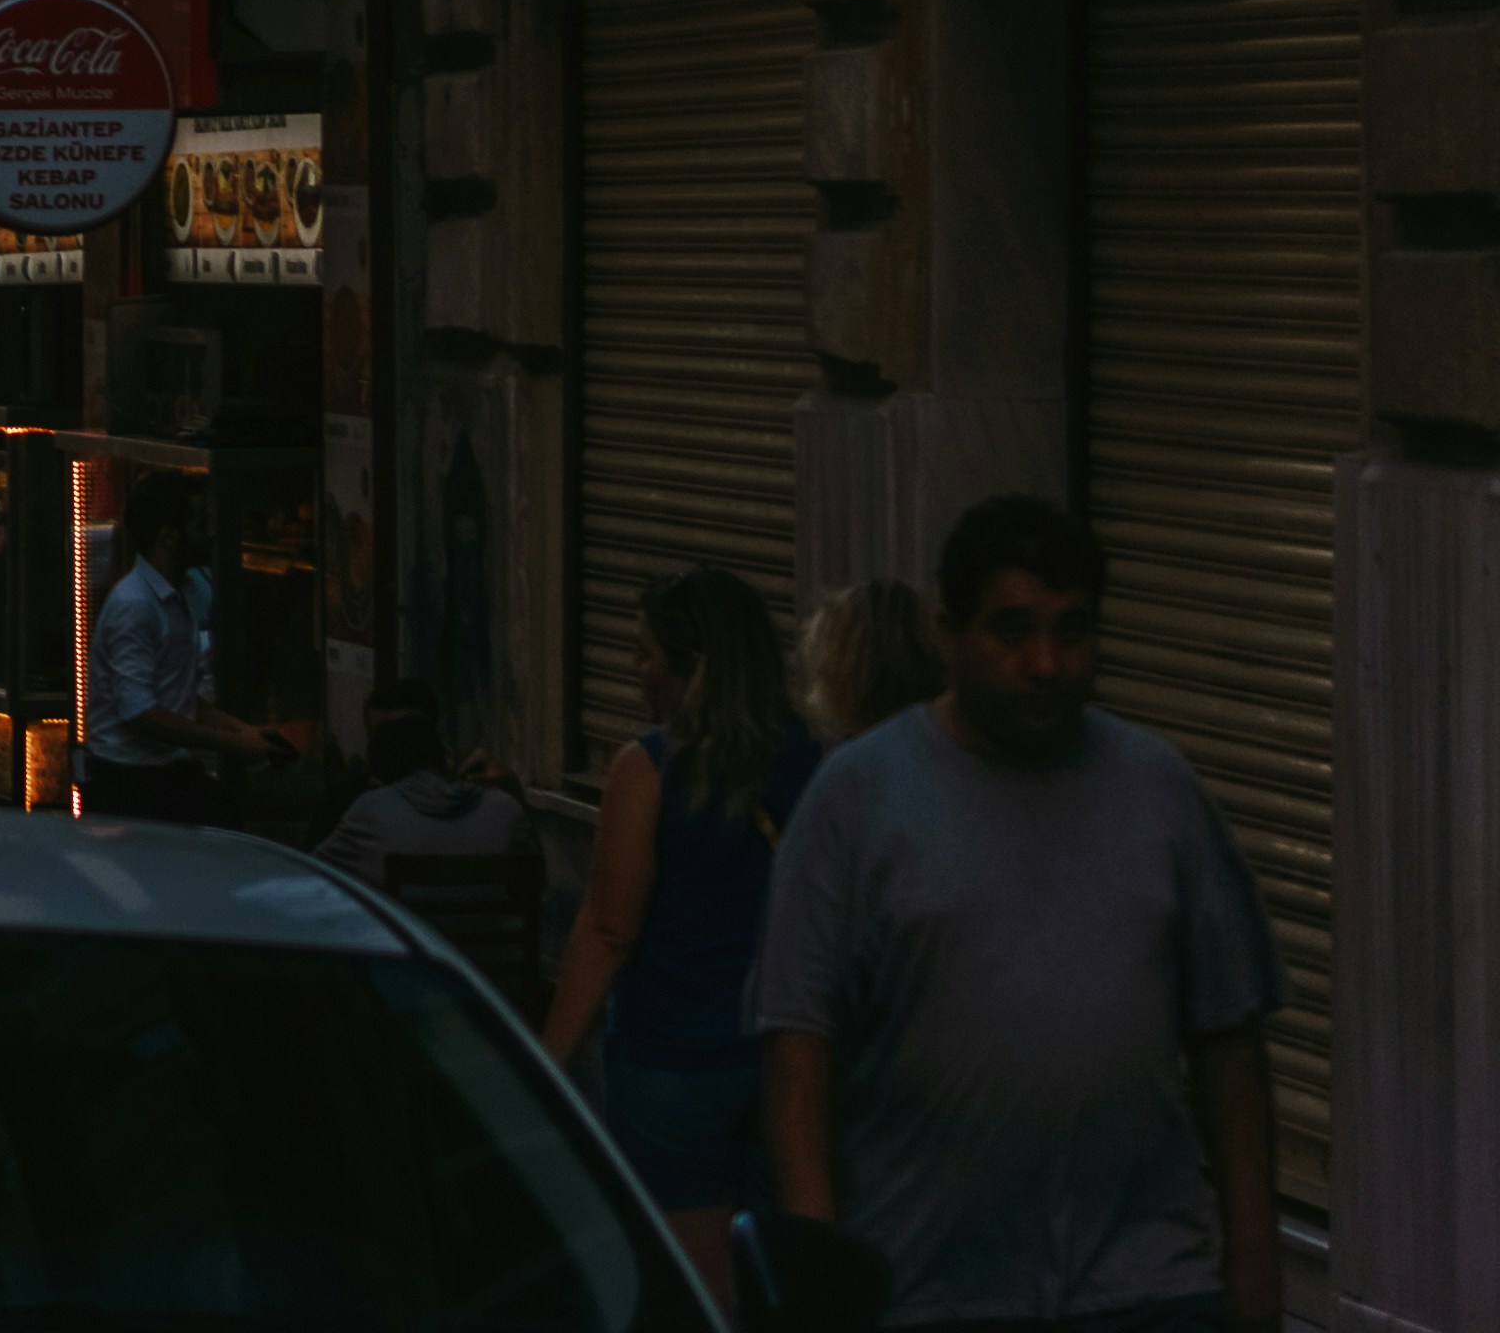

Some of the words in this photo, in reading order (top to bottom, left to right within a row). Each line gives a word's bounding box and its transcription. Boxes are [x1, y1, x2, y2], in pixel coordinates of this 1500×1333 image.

[56, 86, 113, 100] Mucize
[53, 141, 145, 162] KÜNEFE
[18, 169, 96, 185] KEBAP
[9, 193, 104, 210] SALONU
